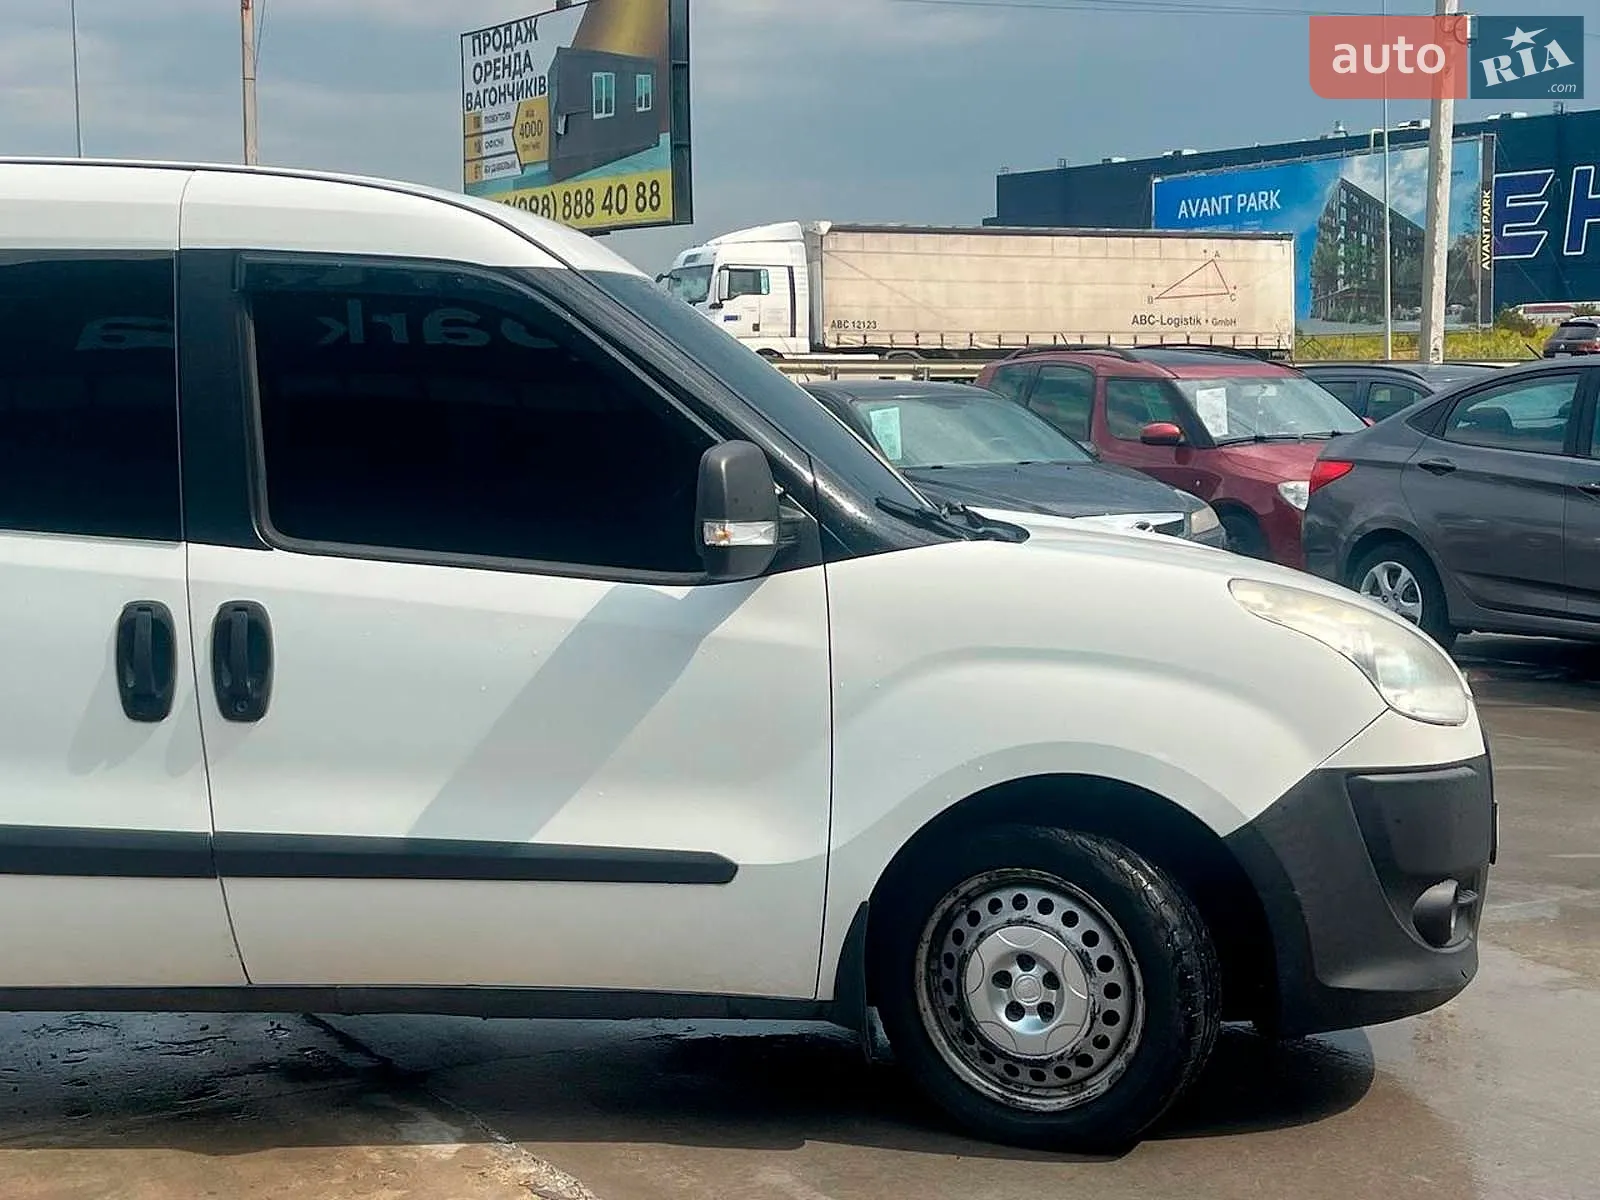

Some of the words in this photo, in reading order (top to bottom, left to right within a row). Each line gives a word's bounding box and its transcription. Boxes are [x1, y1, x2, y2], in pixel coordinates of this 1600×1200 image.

[471, 18, 539, 57] ПРОДАЖ
[473, 50, 534, 84] ОРЕНДА
[465, 75, 547, 113] ВАГОНЧИКІВ
[519, 119, 544, 139] 4000
[562, 187, 595, 221] 888
[601, 183, 628, 216] 40
[635, 179, 661, 213] 88
[1177, 194, 1233, 219] AVANT
[1237, 188, 1281, 213] PARK
[1481, 189, 1491, 227] PARK
[1481, 228, 1492, 270] AVANT
[830, 319, 849, 329] ABC
[1131, 315, 1202, 329] ABC-Logistik
[1211, 317, 1237, 327] GmbH
